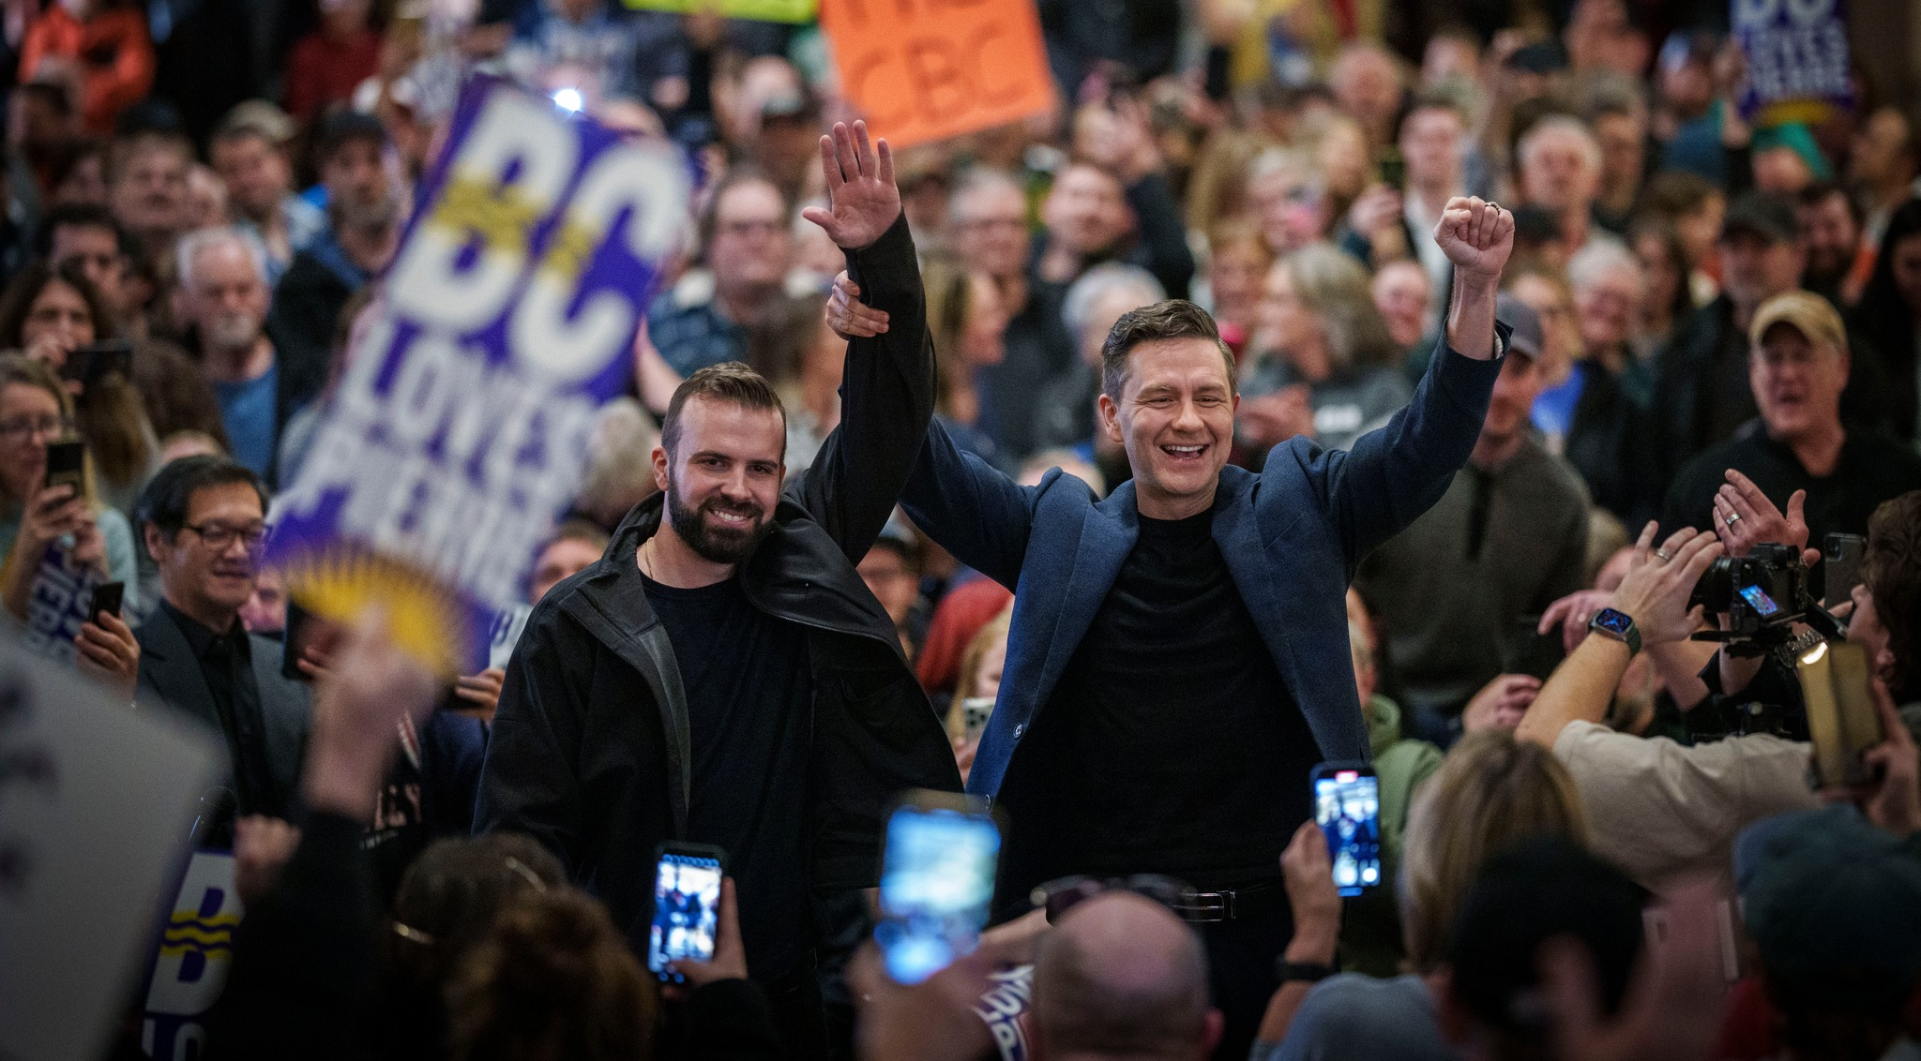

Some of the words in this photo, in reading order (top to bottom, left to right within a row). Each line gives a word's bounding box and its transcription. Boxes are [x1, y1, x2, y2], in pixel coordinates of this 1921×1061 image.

[850, 20, 1033, 131] CBC
[392, 95, 691, 379] BC
[331, 317, 604, 500] LOVES
[146, 852, 246, 1017] B
